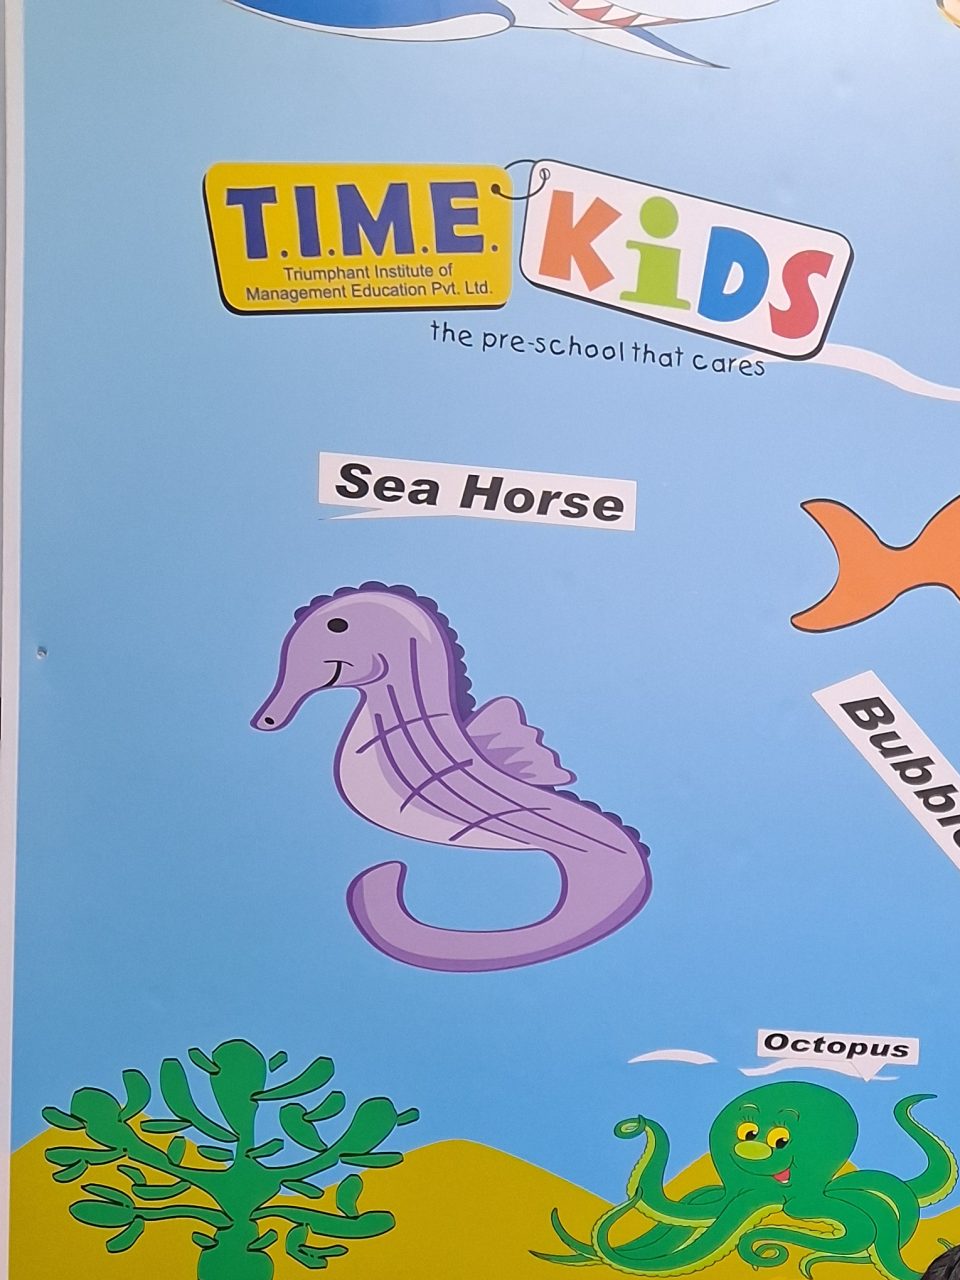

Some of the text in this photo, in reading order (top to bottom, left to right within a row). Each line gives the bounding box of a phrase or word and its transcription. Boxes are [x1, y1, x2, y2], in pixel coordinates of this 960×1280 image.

[226, 181, 498, 259] T.I.M.E.
[246, 280, 493, 303] Management Education Pvt. Ltd.
[284, 262, 454, 284] Triumphant Institute of
[430, 320, 766, 377] the pre-school that cares
[335, 462, 624, 522] Sea Horse
[763, 1032, 910, 1060] Octopus
